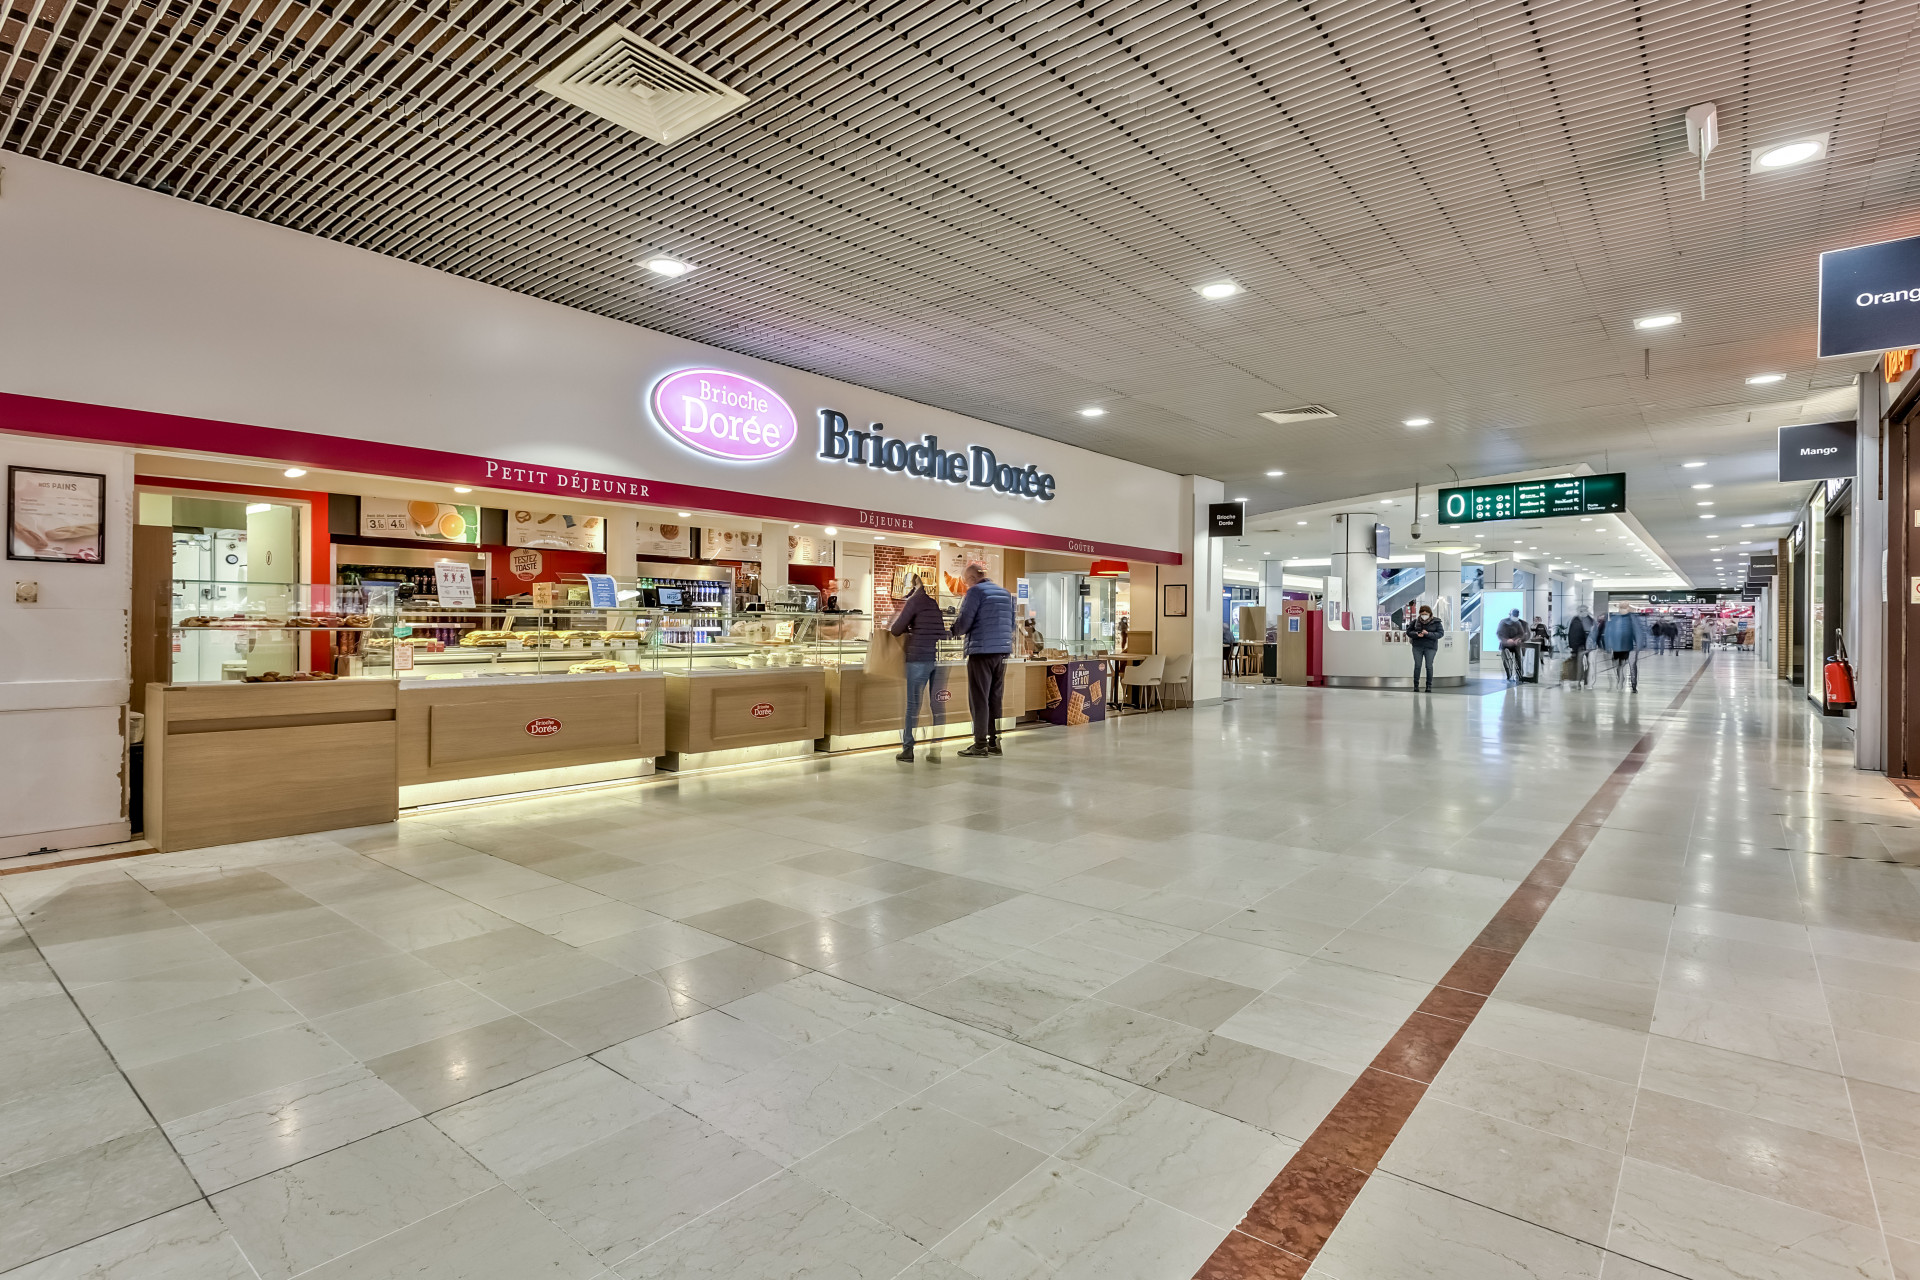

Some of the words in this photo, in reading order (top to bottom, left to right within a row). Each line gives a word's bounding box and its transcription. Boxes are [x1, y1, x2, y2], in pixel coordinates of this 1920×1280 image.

[699, 378, 769, 413] Brioche
[681, 394, 782, 448] Dorée
[818, 408, 968, 483] Brioche
[968, 444, 1057, 500] Dorée
[1800, 447, 1838, 456] Mango
[52, 482, 77, 492] PAINS
[485, 460, 548, 484] PETIT
[557, 472, 650, 497] DÉJEUNER
[1446, 494, 1466, 517] 0
[859, 510, 914, 529] DÉJEUNER
[1068, 540, 1095, 553] GOÛTER
[531, 724, 558, 734] Dorée
